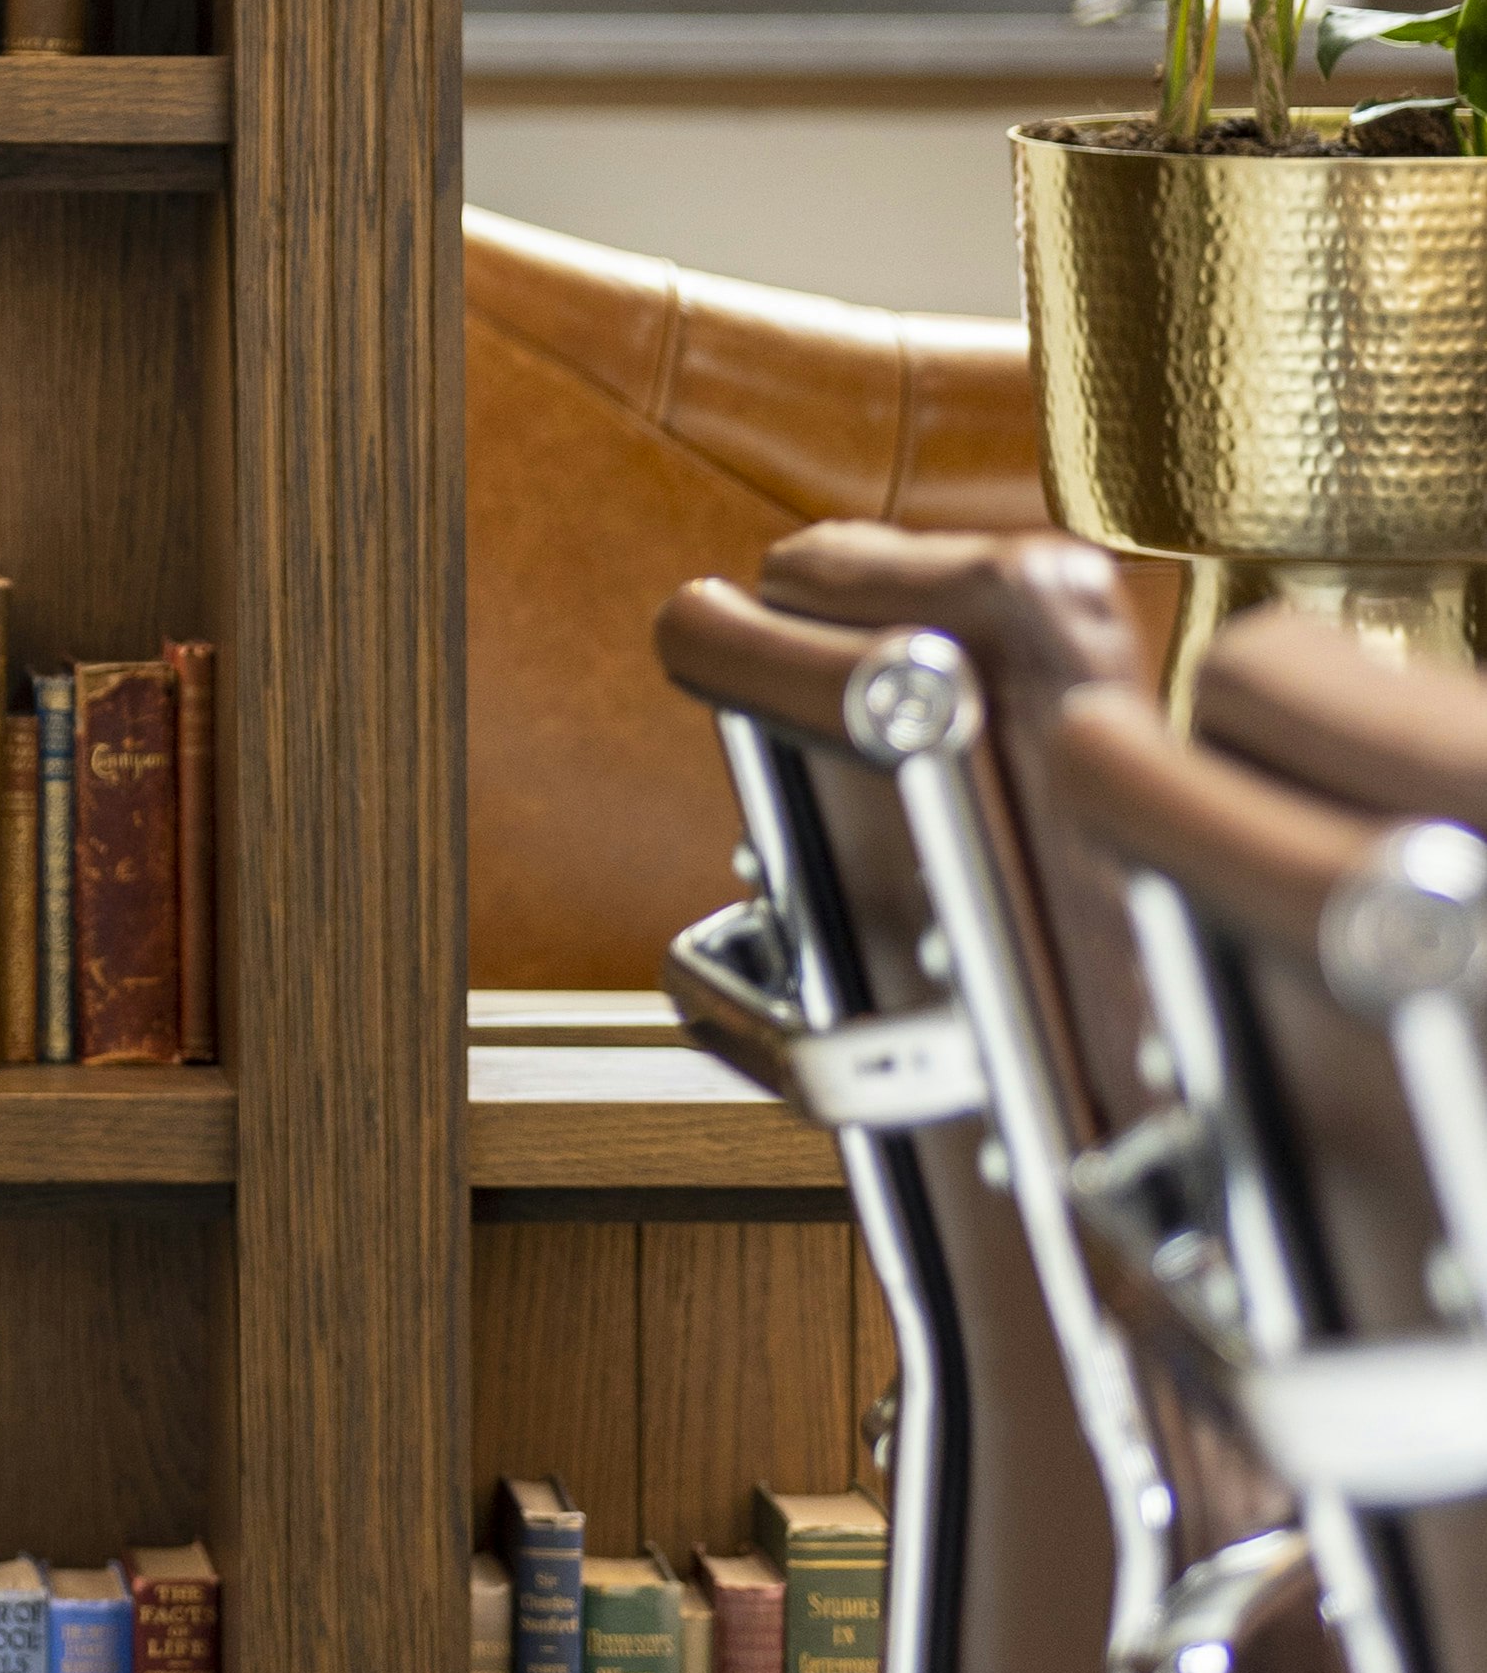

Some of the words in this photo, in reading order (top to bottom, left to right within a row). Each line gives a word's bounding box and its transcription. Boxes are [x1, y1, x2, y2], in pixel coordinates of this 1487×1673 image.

[154, 1584, 204, 1603] THE
[11, 1600, 42, 1625] OF
[139, 1604, 217, 1625] FACTS
[806, 1591, 881, 1619] STUDIES
[832, 1624, 856, 1646] IN
[146, 1638, 208, 1659] LIFE
